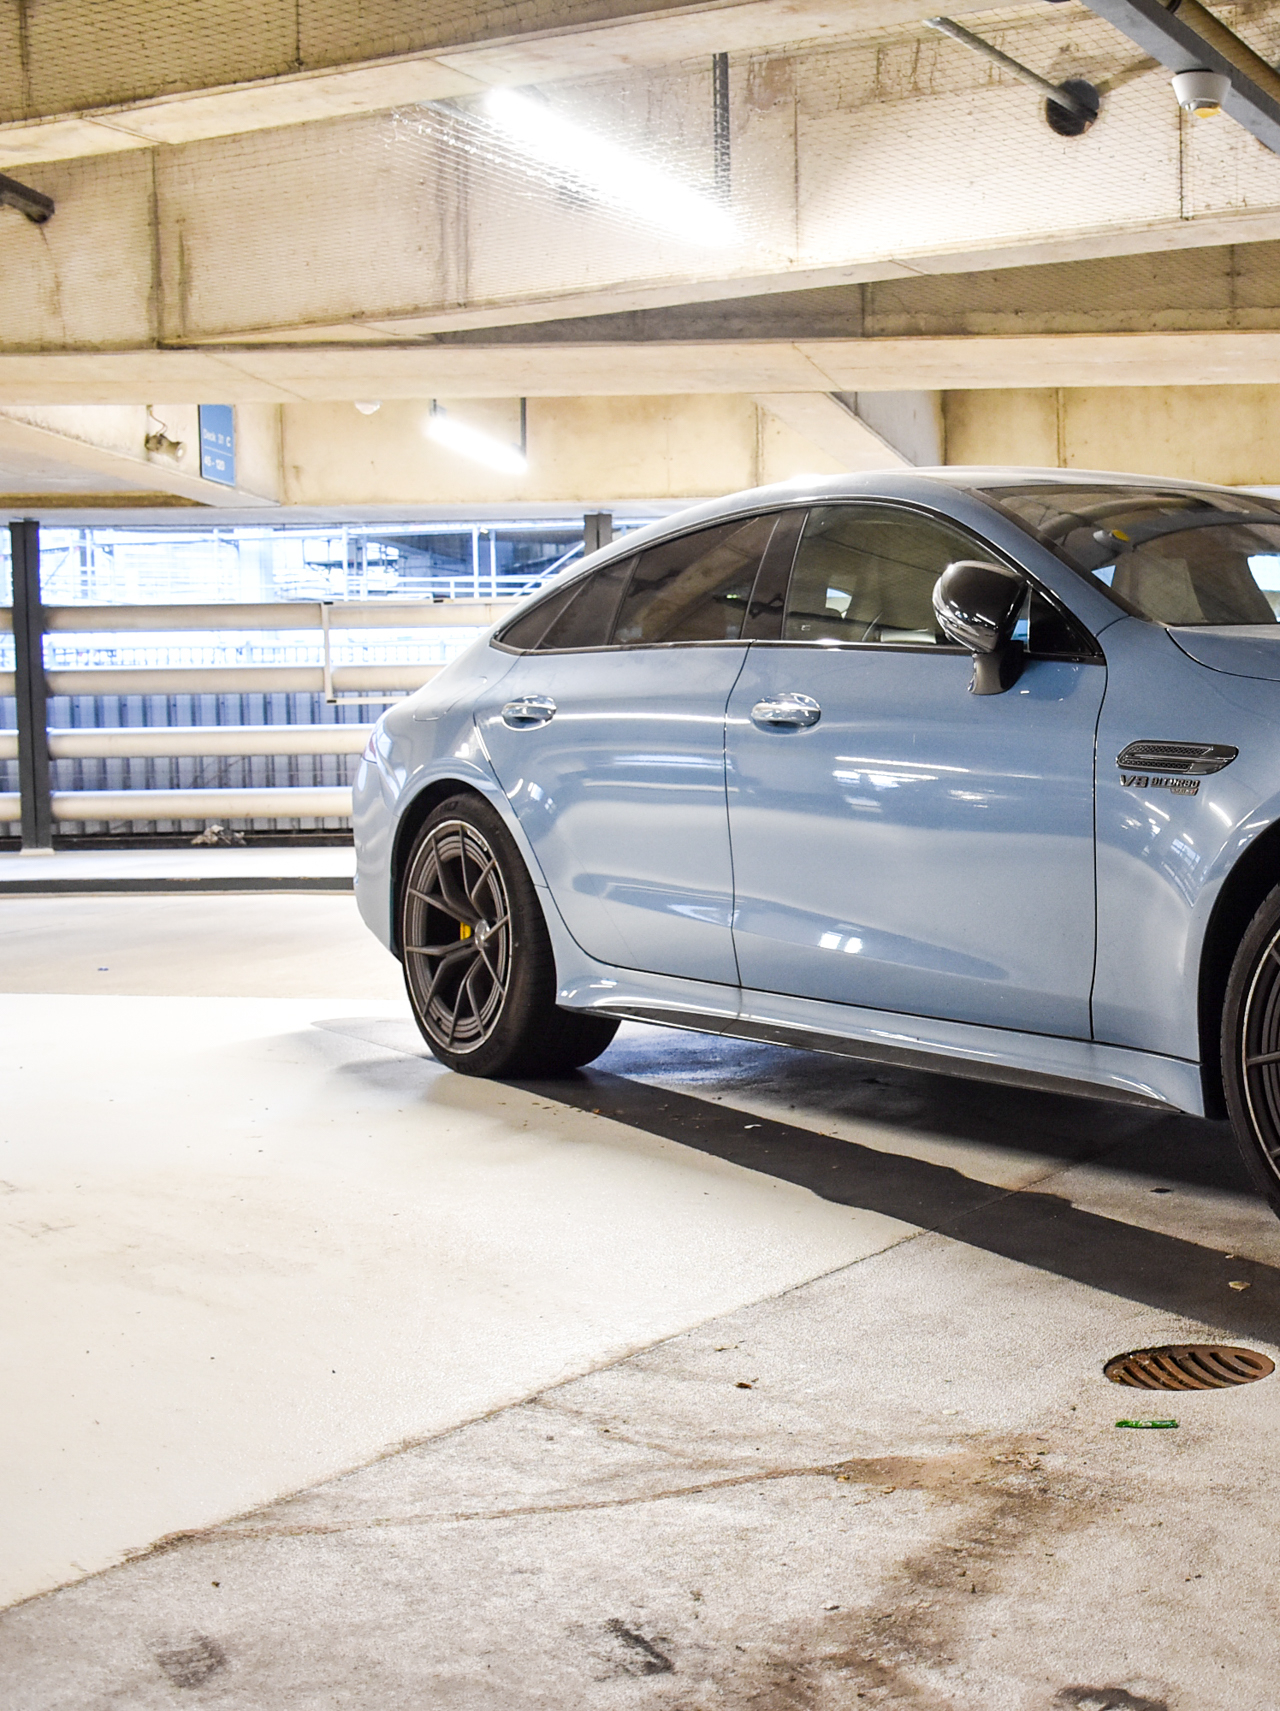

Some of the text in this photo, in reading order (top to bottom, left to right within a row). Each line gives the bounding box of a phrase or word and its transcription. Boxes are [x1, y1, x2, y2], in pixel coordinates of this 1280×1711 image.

[226, 436, 231, 447] C
[1119, 775, 1200, 789] V8 BITURBO
